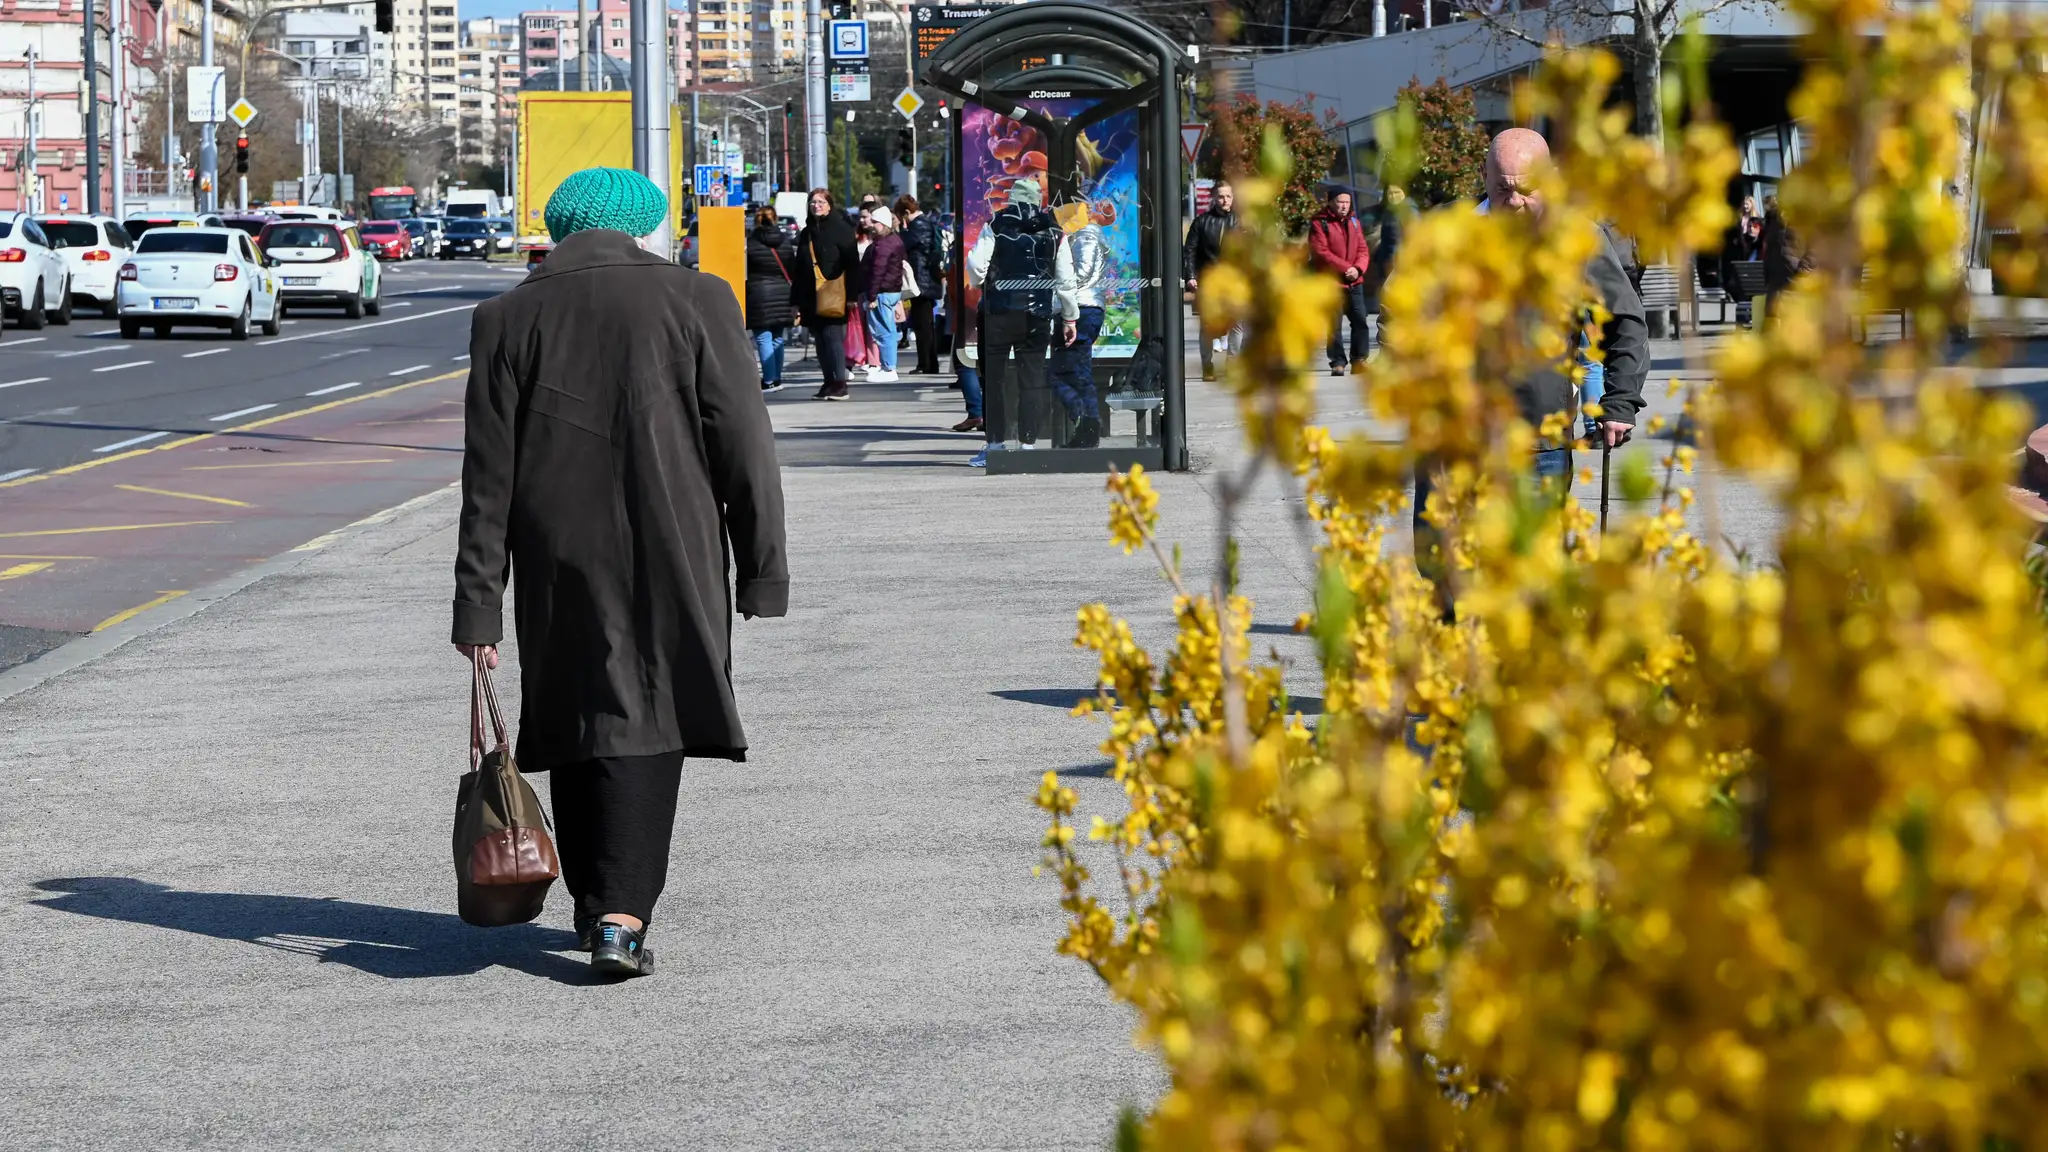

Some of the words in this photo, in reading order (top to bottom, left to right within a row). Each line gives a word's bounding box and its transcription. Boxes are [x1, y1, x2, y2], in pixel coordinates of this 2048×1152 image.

[833, 5, 841, 16] F
[1028, 90, 1071, 99] JCDecaux
[191, 109, 223, 117] NOTR
